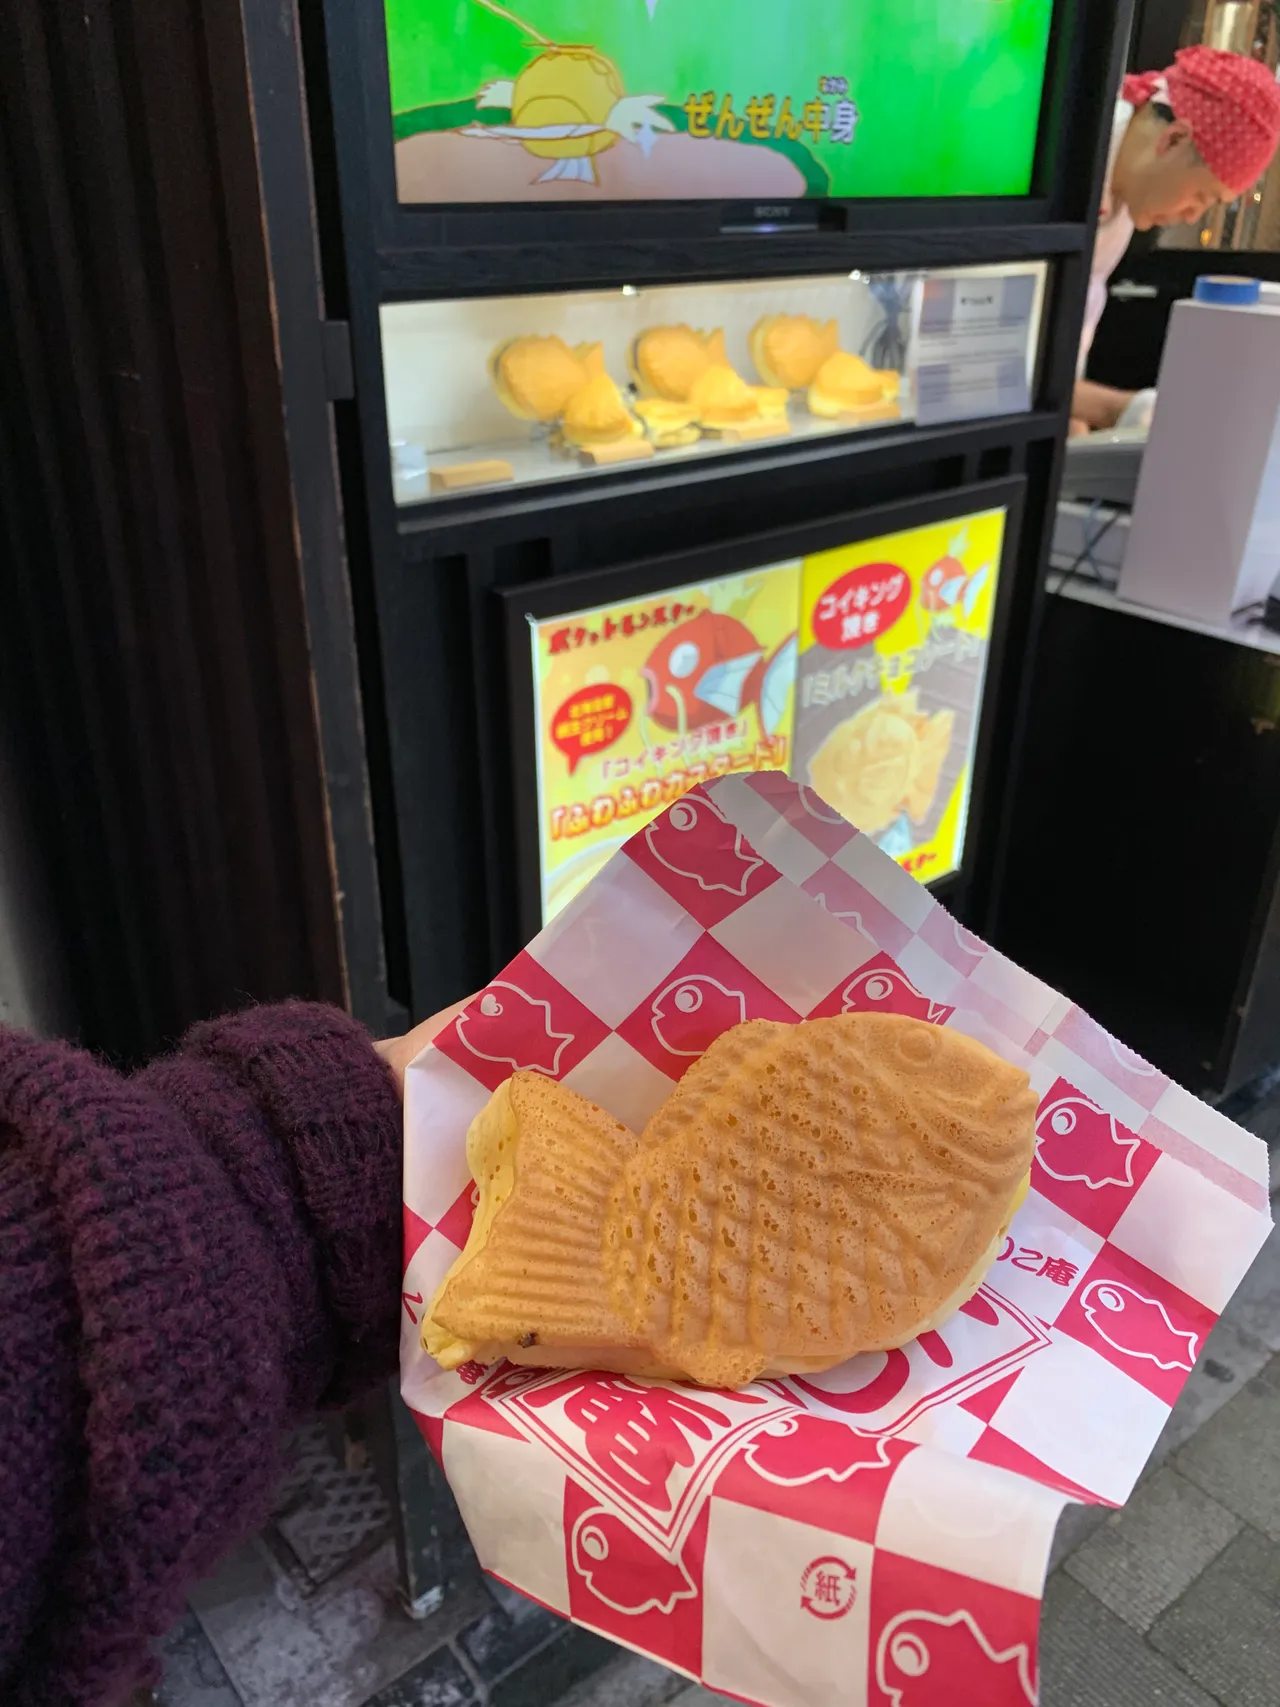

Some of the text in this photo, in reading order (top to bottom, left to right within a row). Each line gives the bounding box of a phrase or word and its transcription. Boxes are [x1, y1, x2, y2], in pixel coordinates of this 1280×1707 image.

[684, 91, 858, 145] ぜんぜん中身
[819, 572, 905, 621] コイキング
[815, 1570, 841, 1607] 紙
